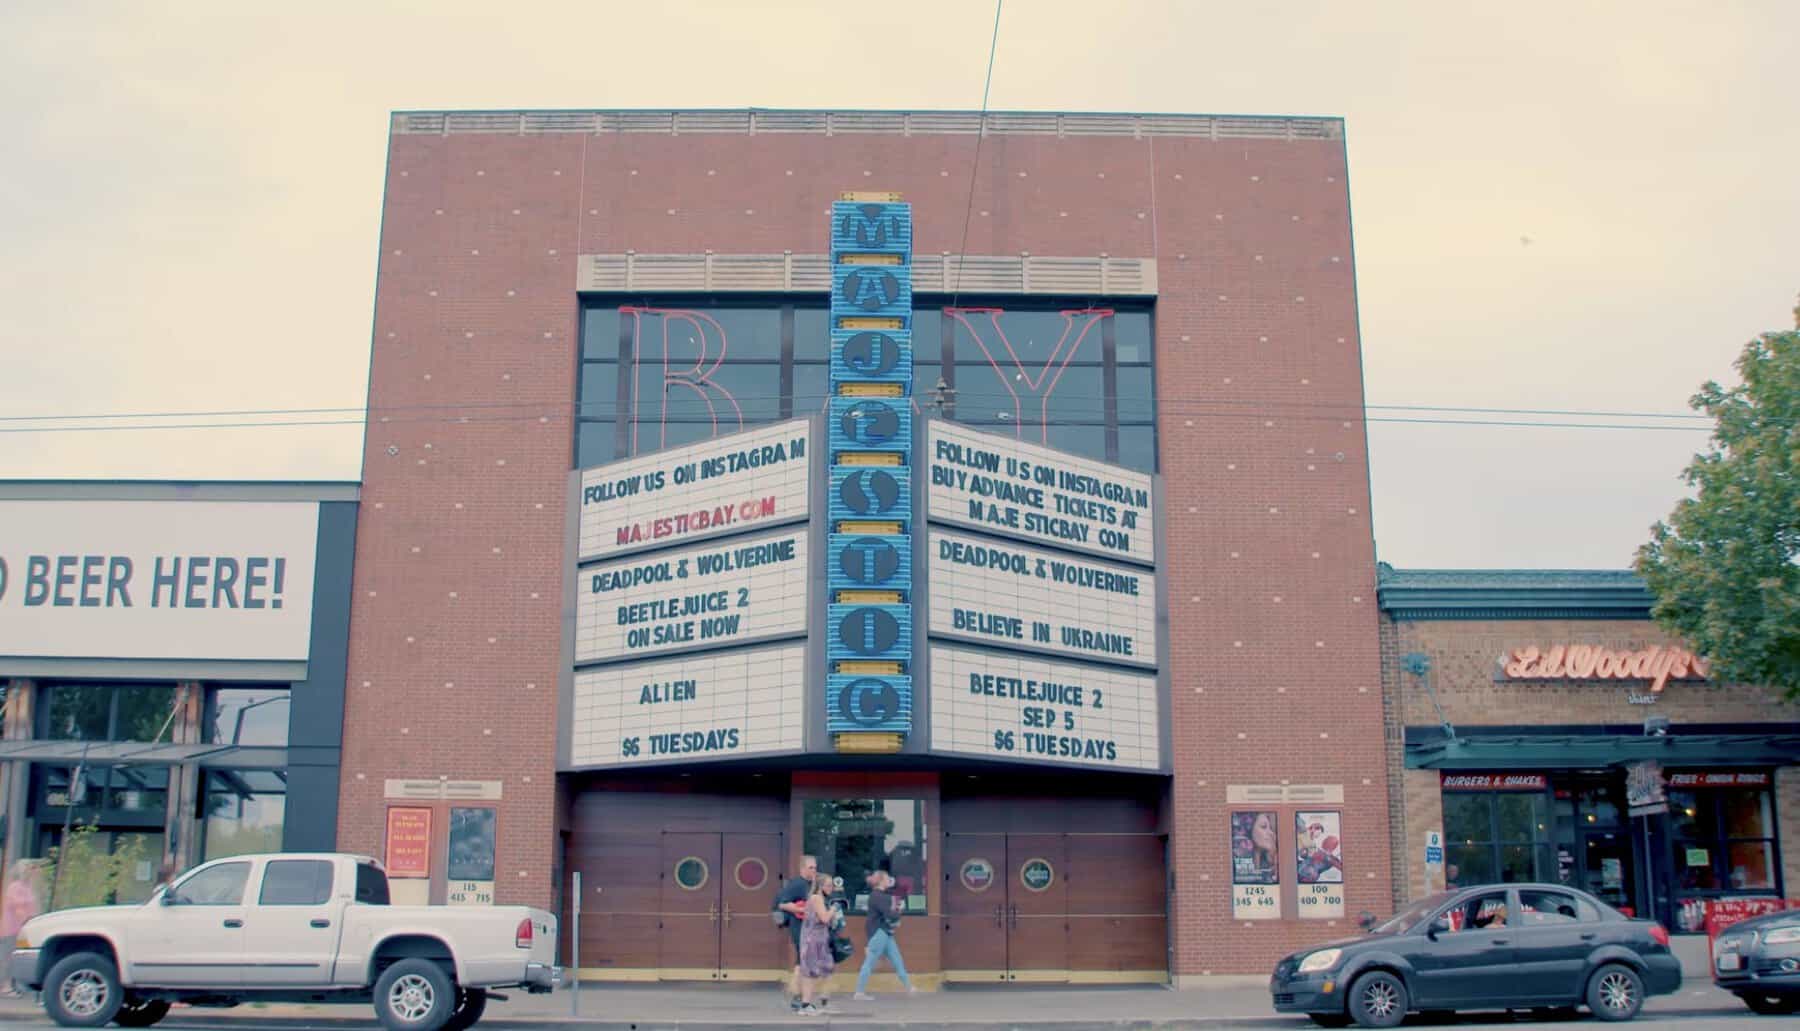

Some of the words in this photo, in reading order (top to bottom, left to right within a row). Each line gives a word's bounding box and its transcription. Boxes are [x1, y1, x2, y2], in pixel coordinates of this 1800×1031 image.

[584, 475, 641, 505] FOLLOW
[645, 471, 665, 492] US
[674, 464, 696, 486] ON
[701, 438, 805, 480] INSTAGRAM
[838, 202, 905, 724] MAJESTIC
[936, 439, 1000, 474] FOLLOW
[1006, 457, 1030, 481] US
[1034, 465, 1055, 487] ON
[1059, 470, 1148, 509] INSTAGRAM
[932, 464, 967, 491] BUY
[969, 473, 1044, 510] ADVANCE
[1053, 493, 1117, 525] TICKETS
[1121, 509, 1139, 530] AT
[1098, 528, 1130, 552] COM
[23, 555, 134, 608] BEER
[150, 556, 287, 609] HERE!
[592, 562, 673, 594] DEADPOOL
[677, 560, 689, 579] &
[697, 539, 795, 576] WOLVERINE
[939, 539, 1031, 576] DEADPOOL
[1034, 558, 1047, 580] &
[1050, 560, 1139, 596] WOLVERINE
[617, 591, 729, 626] BEETLEJUICE
[737, 587, 749, 607] 2
[628, 628, 650, 649] ON
[654, 622, 695, 645] SALE
[700, 614, 740, 639] NOW
[953, 608, 1024, 639] BELIEVE
[1032, 621, 1050, 643] IN
[1061, 625, 1133, 656] UKRAINE
[640, 679, 696, 705] ALIEN
[970, 672, 1083, 707] BEETLEJUICE
[1092, 689, 1103, 709] 2
[1023, 707, 1056, 729] SEP
[1064, 711, 1074, 731] 5
[622, 737, 640, 758] $6
[648, 728, 740, 755] TUESDAYS
[994, 729, 1015, 751] $6
[1022, 733, 1117, 761] TUESDAYS
[1444, 775, 1490, 786] BURGERS
[1504, 775, 1541, 785] SHAKES
[463, 883, 477, 892] 115
[1245, 887, 1265, 896] 1245
[1312, 885, 1328, 894] 100
[1324, 896, 1341, 905] 700
